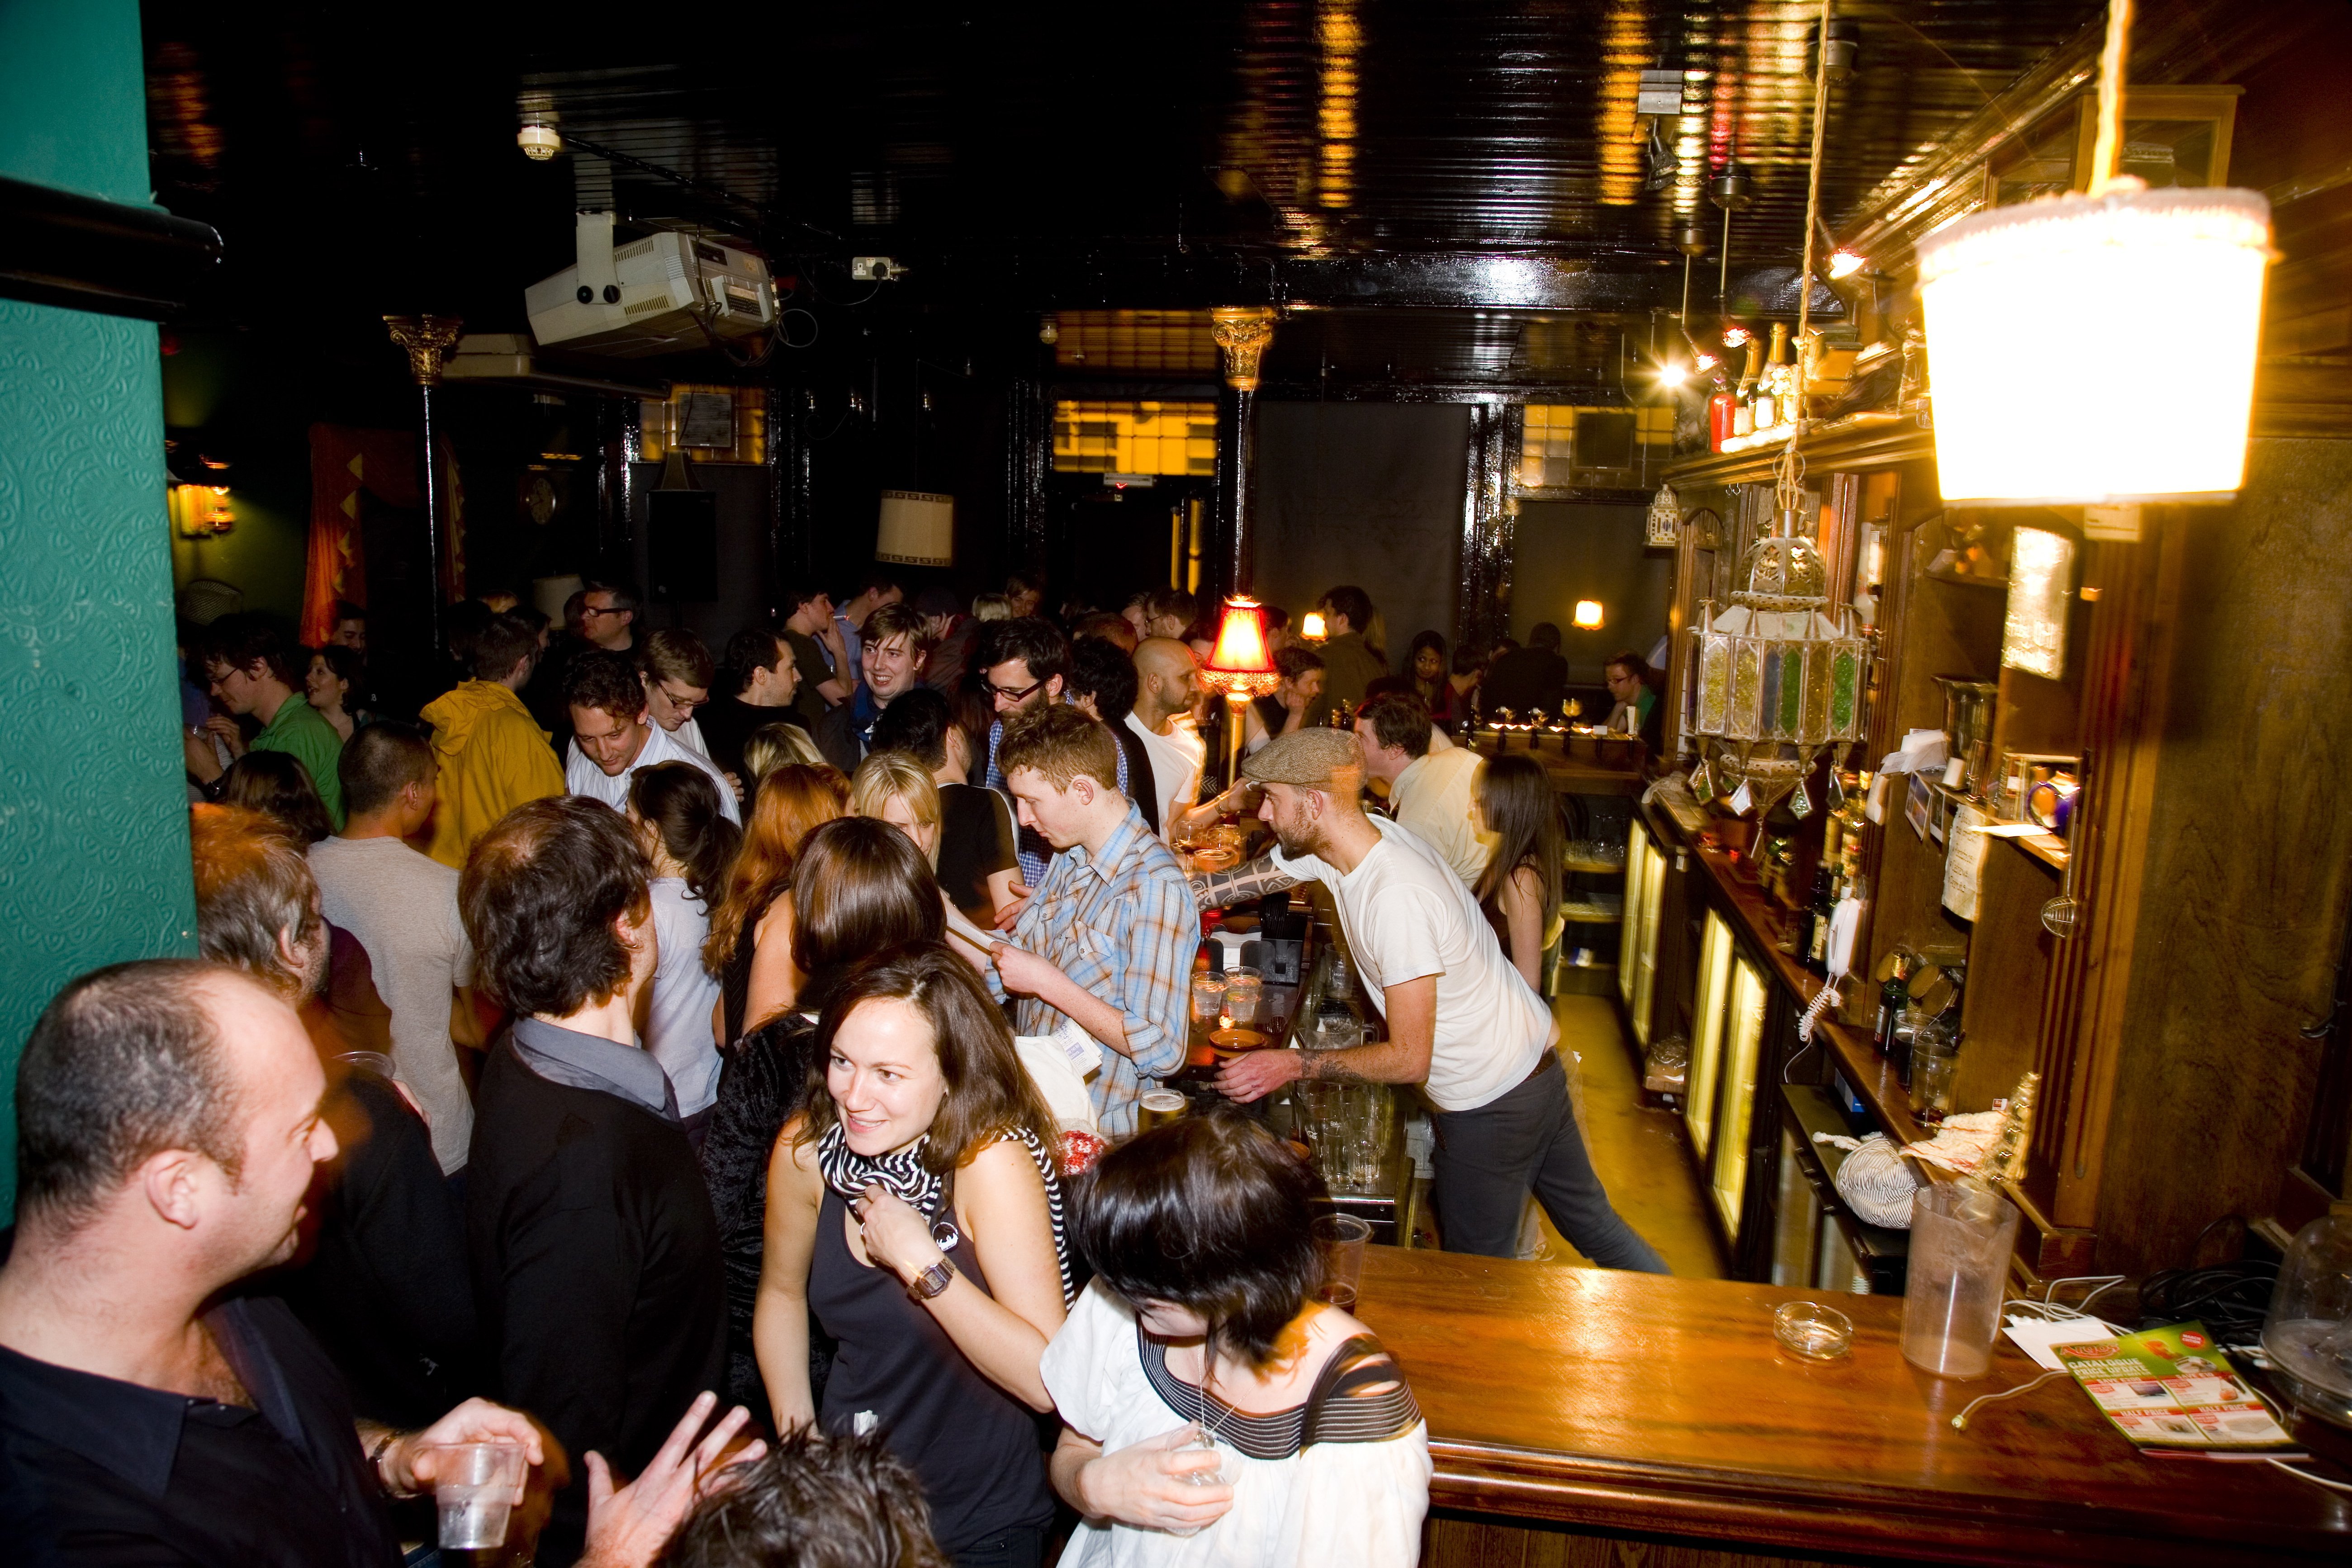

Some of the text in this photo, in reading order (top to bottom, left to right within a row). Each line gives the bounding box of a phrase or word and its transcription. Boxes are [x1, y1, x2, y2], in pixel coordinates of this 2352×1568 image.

[2060, 1343, 2120, 1358] Argos
[2067, 1358, 2142, 1369] CATALOGUE
[2073, 1367, 2106, 1376] PRICE
[2106, 1365, 2149, 1373] UPDATE
